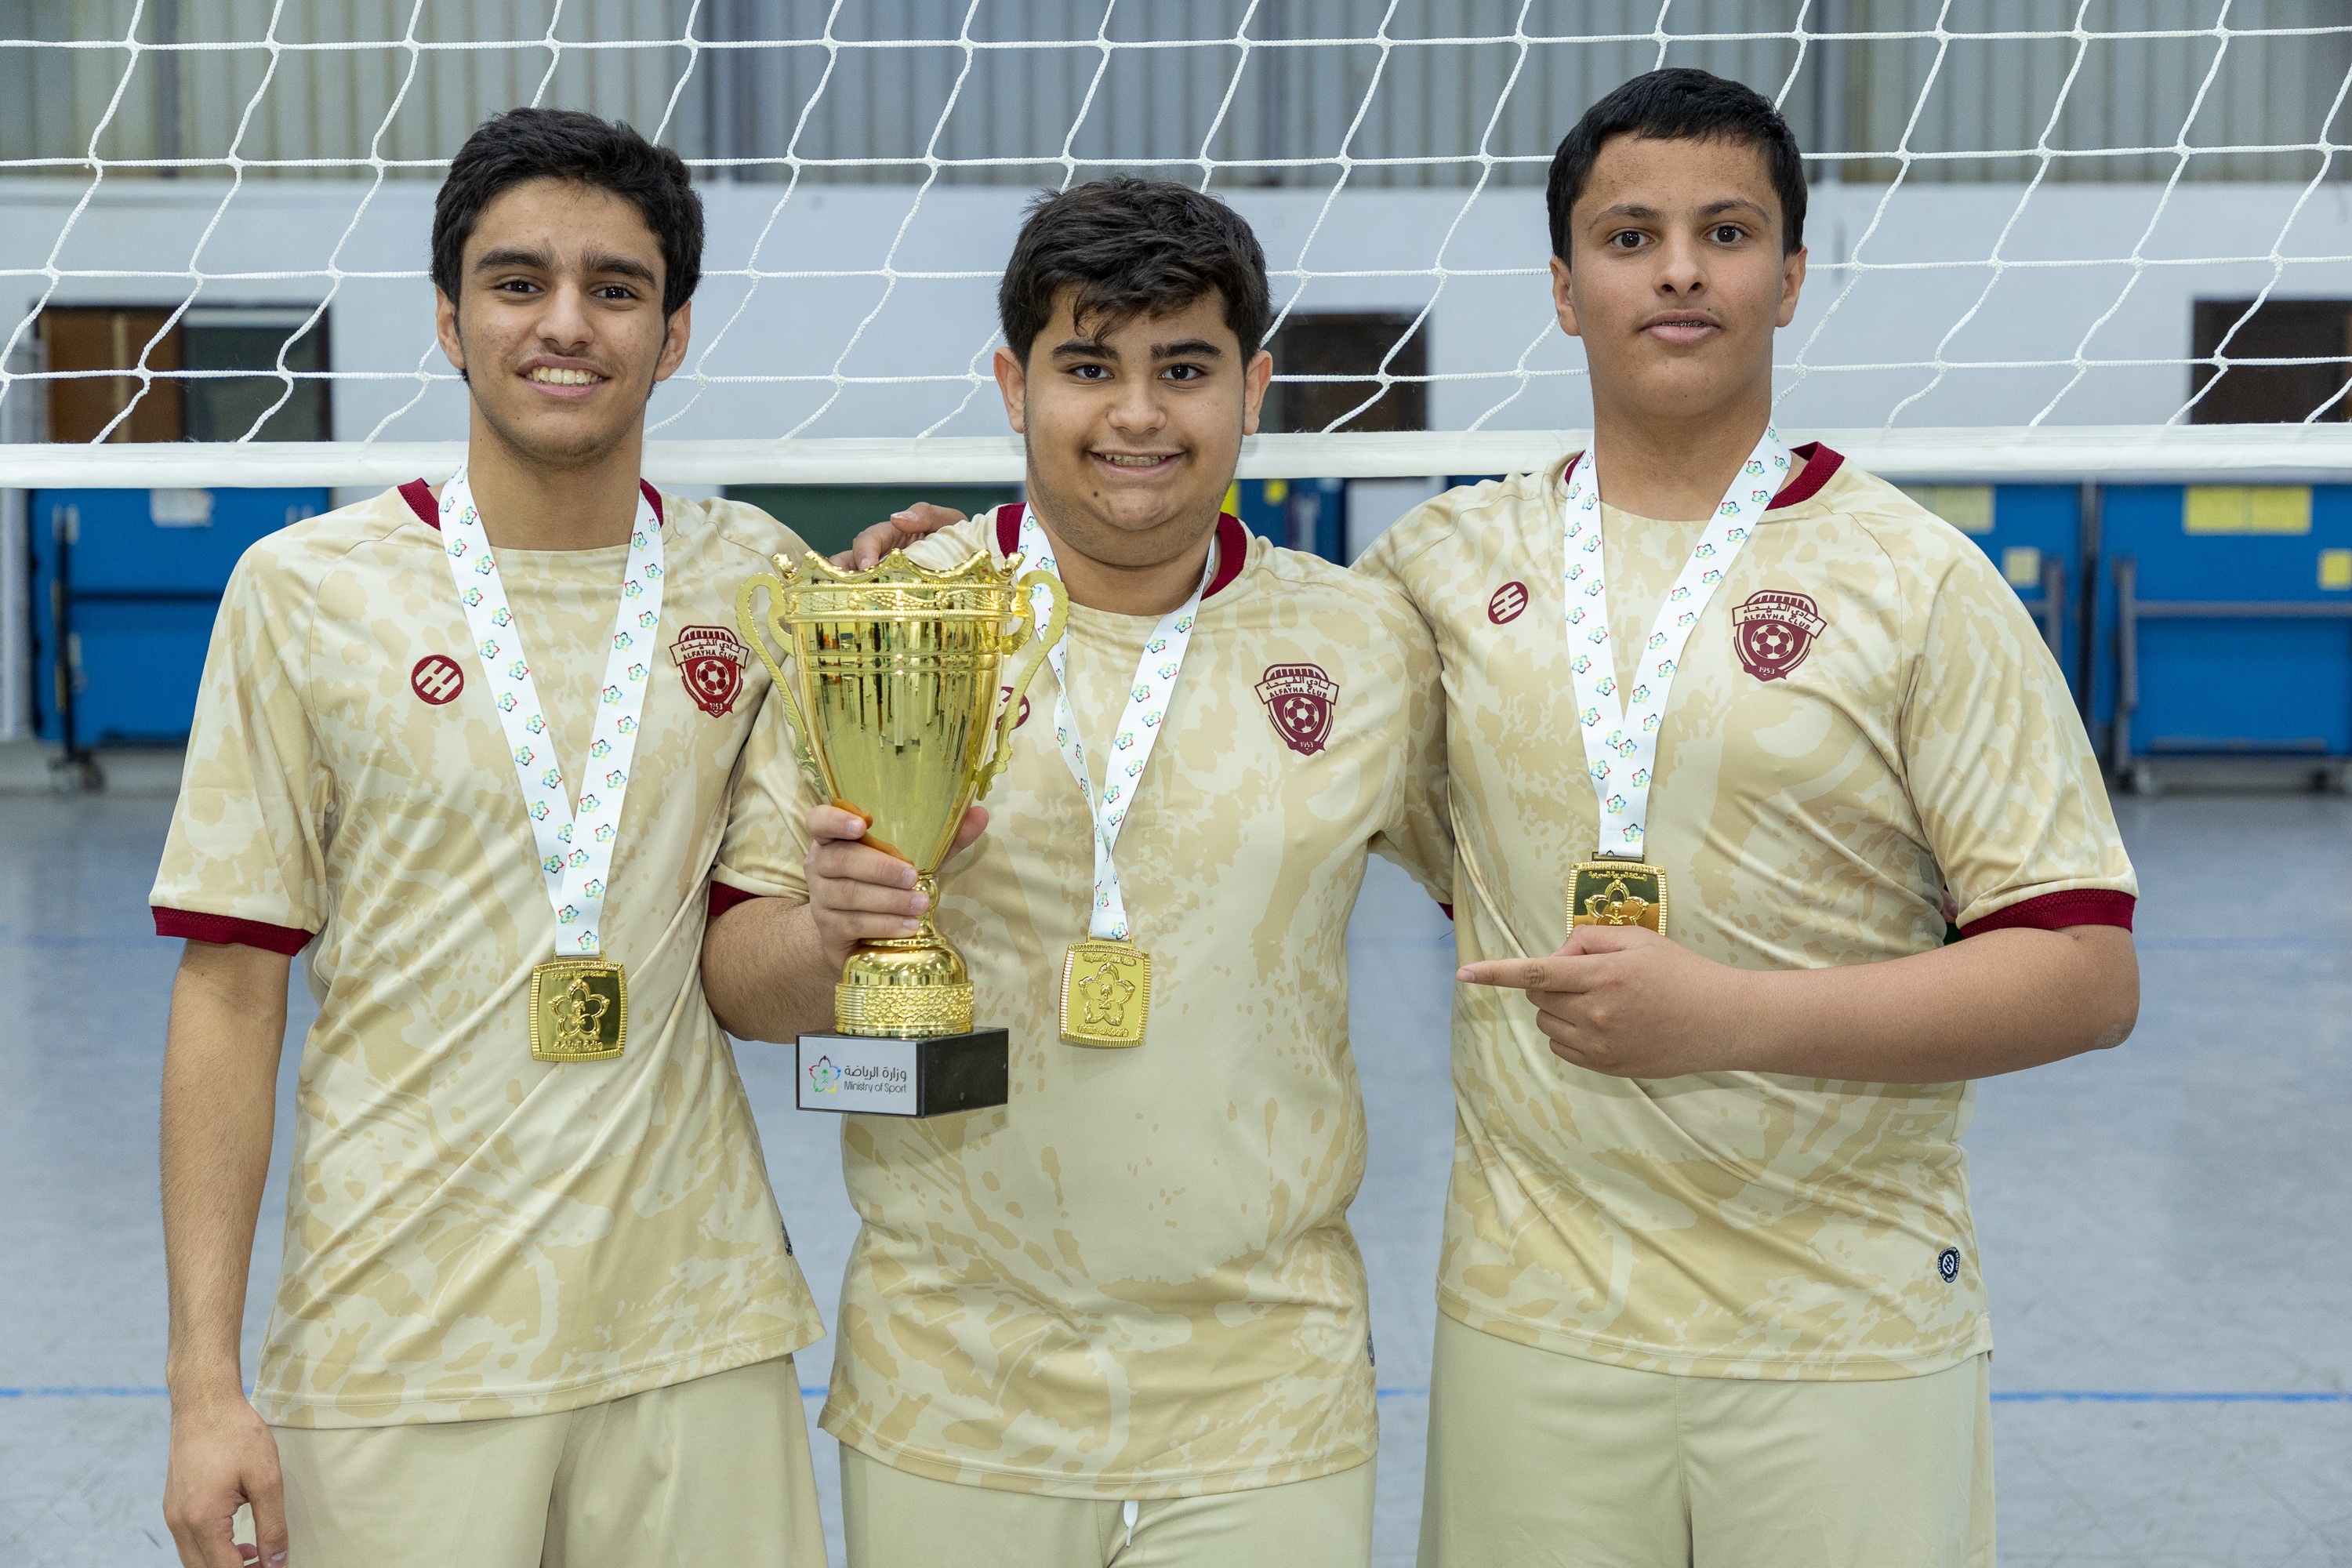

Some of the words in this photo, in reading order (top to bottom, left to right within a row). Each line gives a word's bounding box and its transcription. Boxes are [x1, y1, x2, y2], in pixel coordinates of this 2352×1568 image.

[1744, 603, 1790, 614] الفيحاء
[1744, 613, 1784, 622] ALFAYHA
[1788, 617, 1811, 630] CLUB
[1791, 609, 1818, 623] نادي
[683, 649, 717, 661] ALFAYHA
[719, 651, 739, 662] CLUB
[1266, 675, 1305, 691] الفيحاء
[1306, 679, 1330, 691] نادي
[1269, 687, 1304, 699] ALFAYHA
[1306, 688, 1327, 699] CLUB
[844, 1065, 879, 1080] الرياضة
[882, 1066, 907, 1082] وزارة
[844, 1080, 873, 1094] Ministry
[874, 1083, 884, 1092] of
[884, 1083, 907, 1094] Sport
